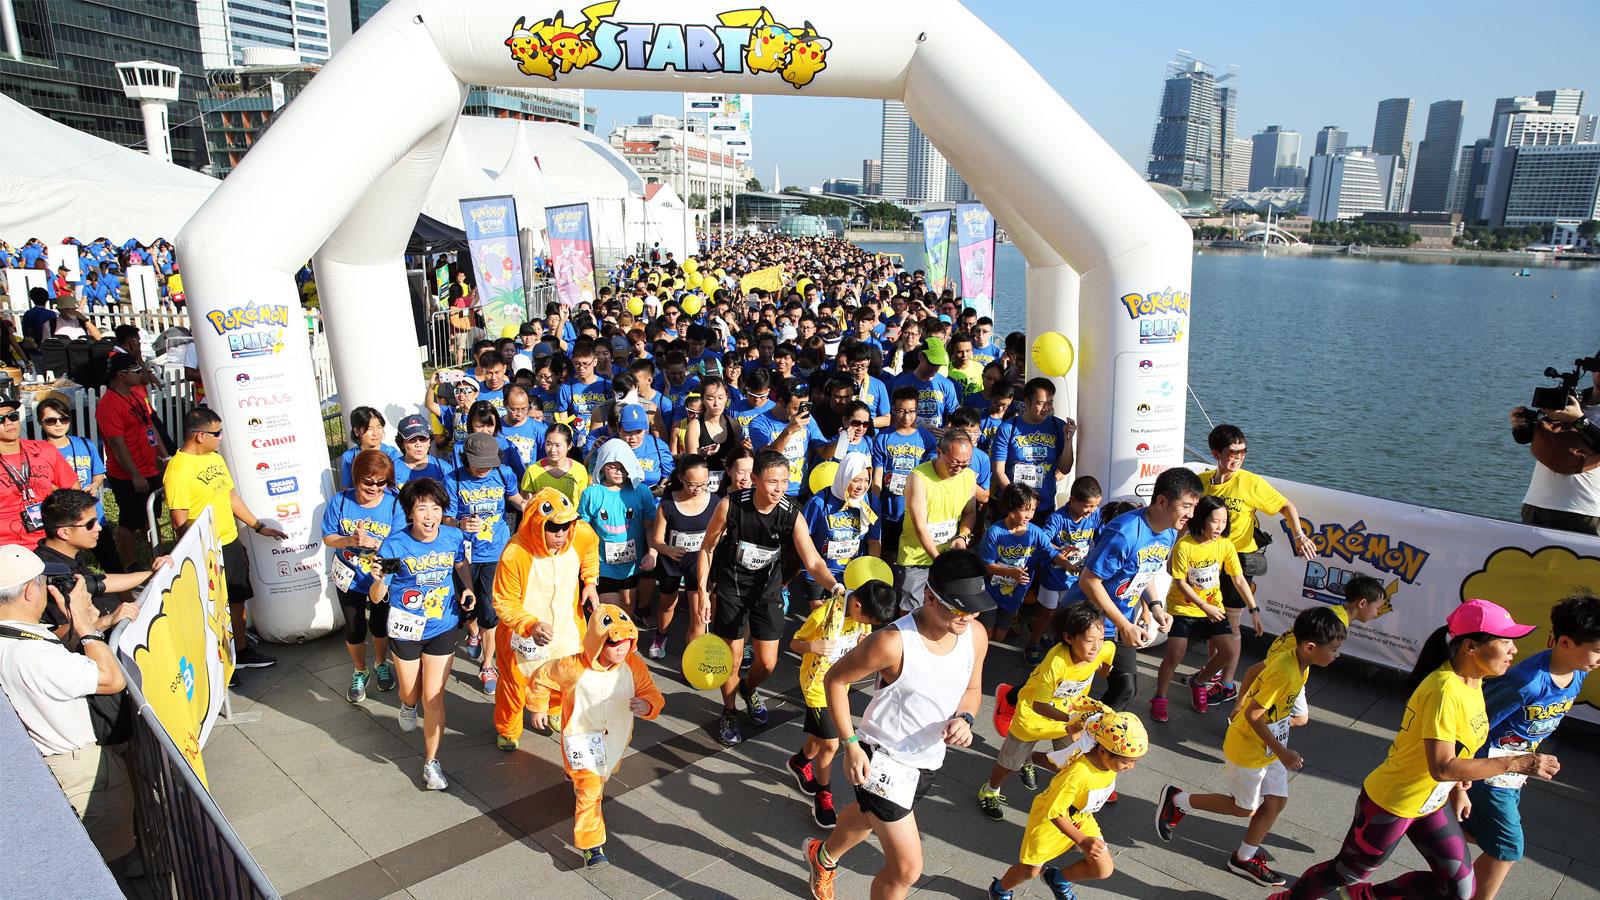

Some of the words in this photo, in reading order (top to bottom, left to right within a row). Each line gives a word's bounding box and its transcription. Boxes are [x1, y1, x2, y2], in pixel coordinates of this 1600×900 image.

[595, 21, 753, 73] START
[251, 434, 296, 448] Canon
[393, 622, 413, 633] 3781
[20, 631, 45, 641] Nikon
